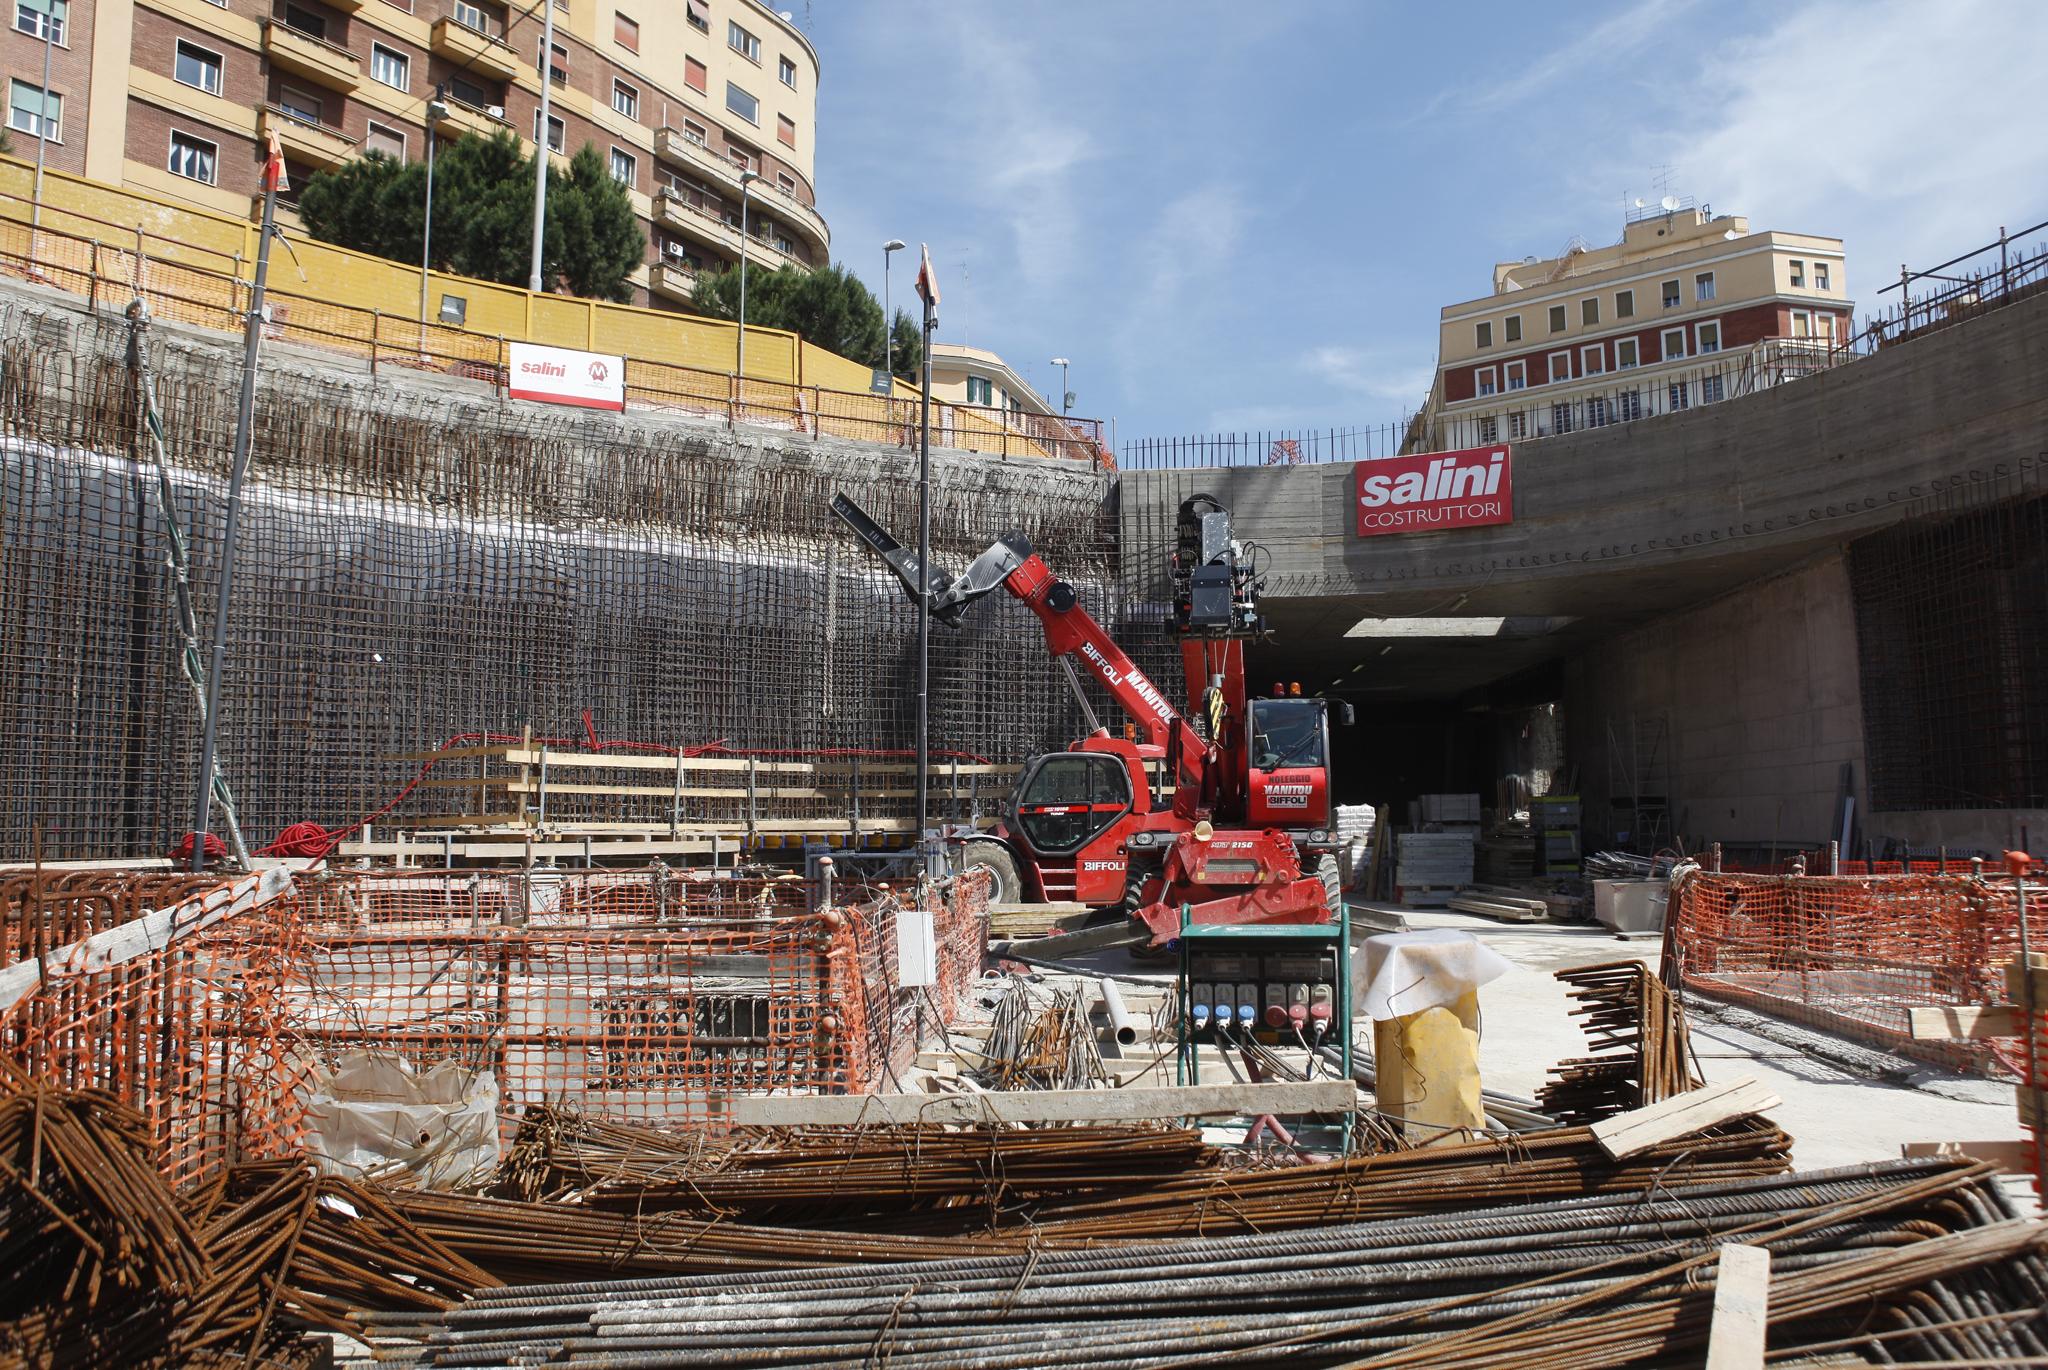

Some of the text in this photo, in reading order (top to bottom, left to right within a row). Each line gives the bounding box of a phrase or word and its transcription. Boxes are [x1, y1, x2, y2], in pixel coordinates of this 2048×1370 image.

[521, 361, 566, 377] salini
[1361, 452, 1505, 508] salini
[1364, 502, 1501, 528] COSTRUTTORI
[1082, 641, 1123, 687] BIFFOLI
[1268, 774, 1312, 784] NOLEGGIO
[1263, 784, 1313, 796] MANITOU
[1268, 796, 1307, 805] BIFFOLI
[1084, 861, 1125, 871] BIFFOLI
